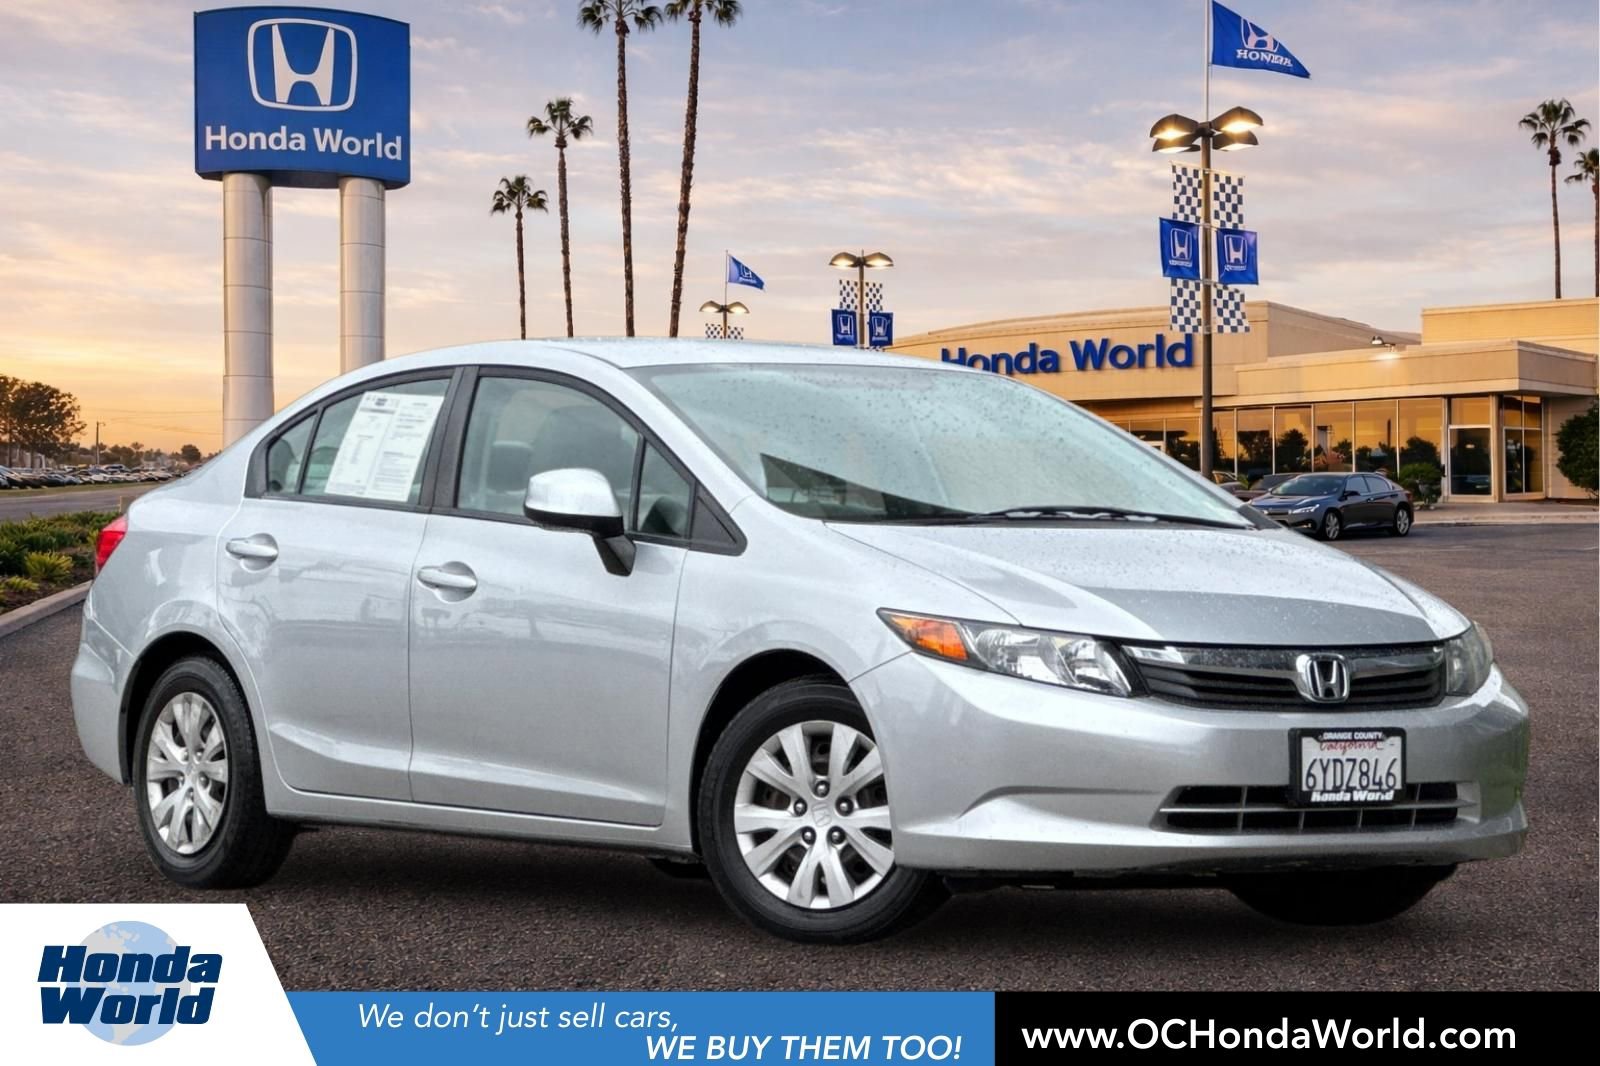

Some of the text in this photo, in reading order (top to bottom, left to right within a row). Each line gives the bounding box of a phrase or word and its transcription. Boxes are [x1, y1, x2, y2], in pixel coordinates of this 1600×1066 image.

[205, 125, 402, 161] Honda World
[941, 332, 1193, 375] Honda World
[1323, 732, 1383, 740] ORANGE COUNTY
[1305, 758, 1398, 791] 6YDZ846
